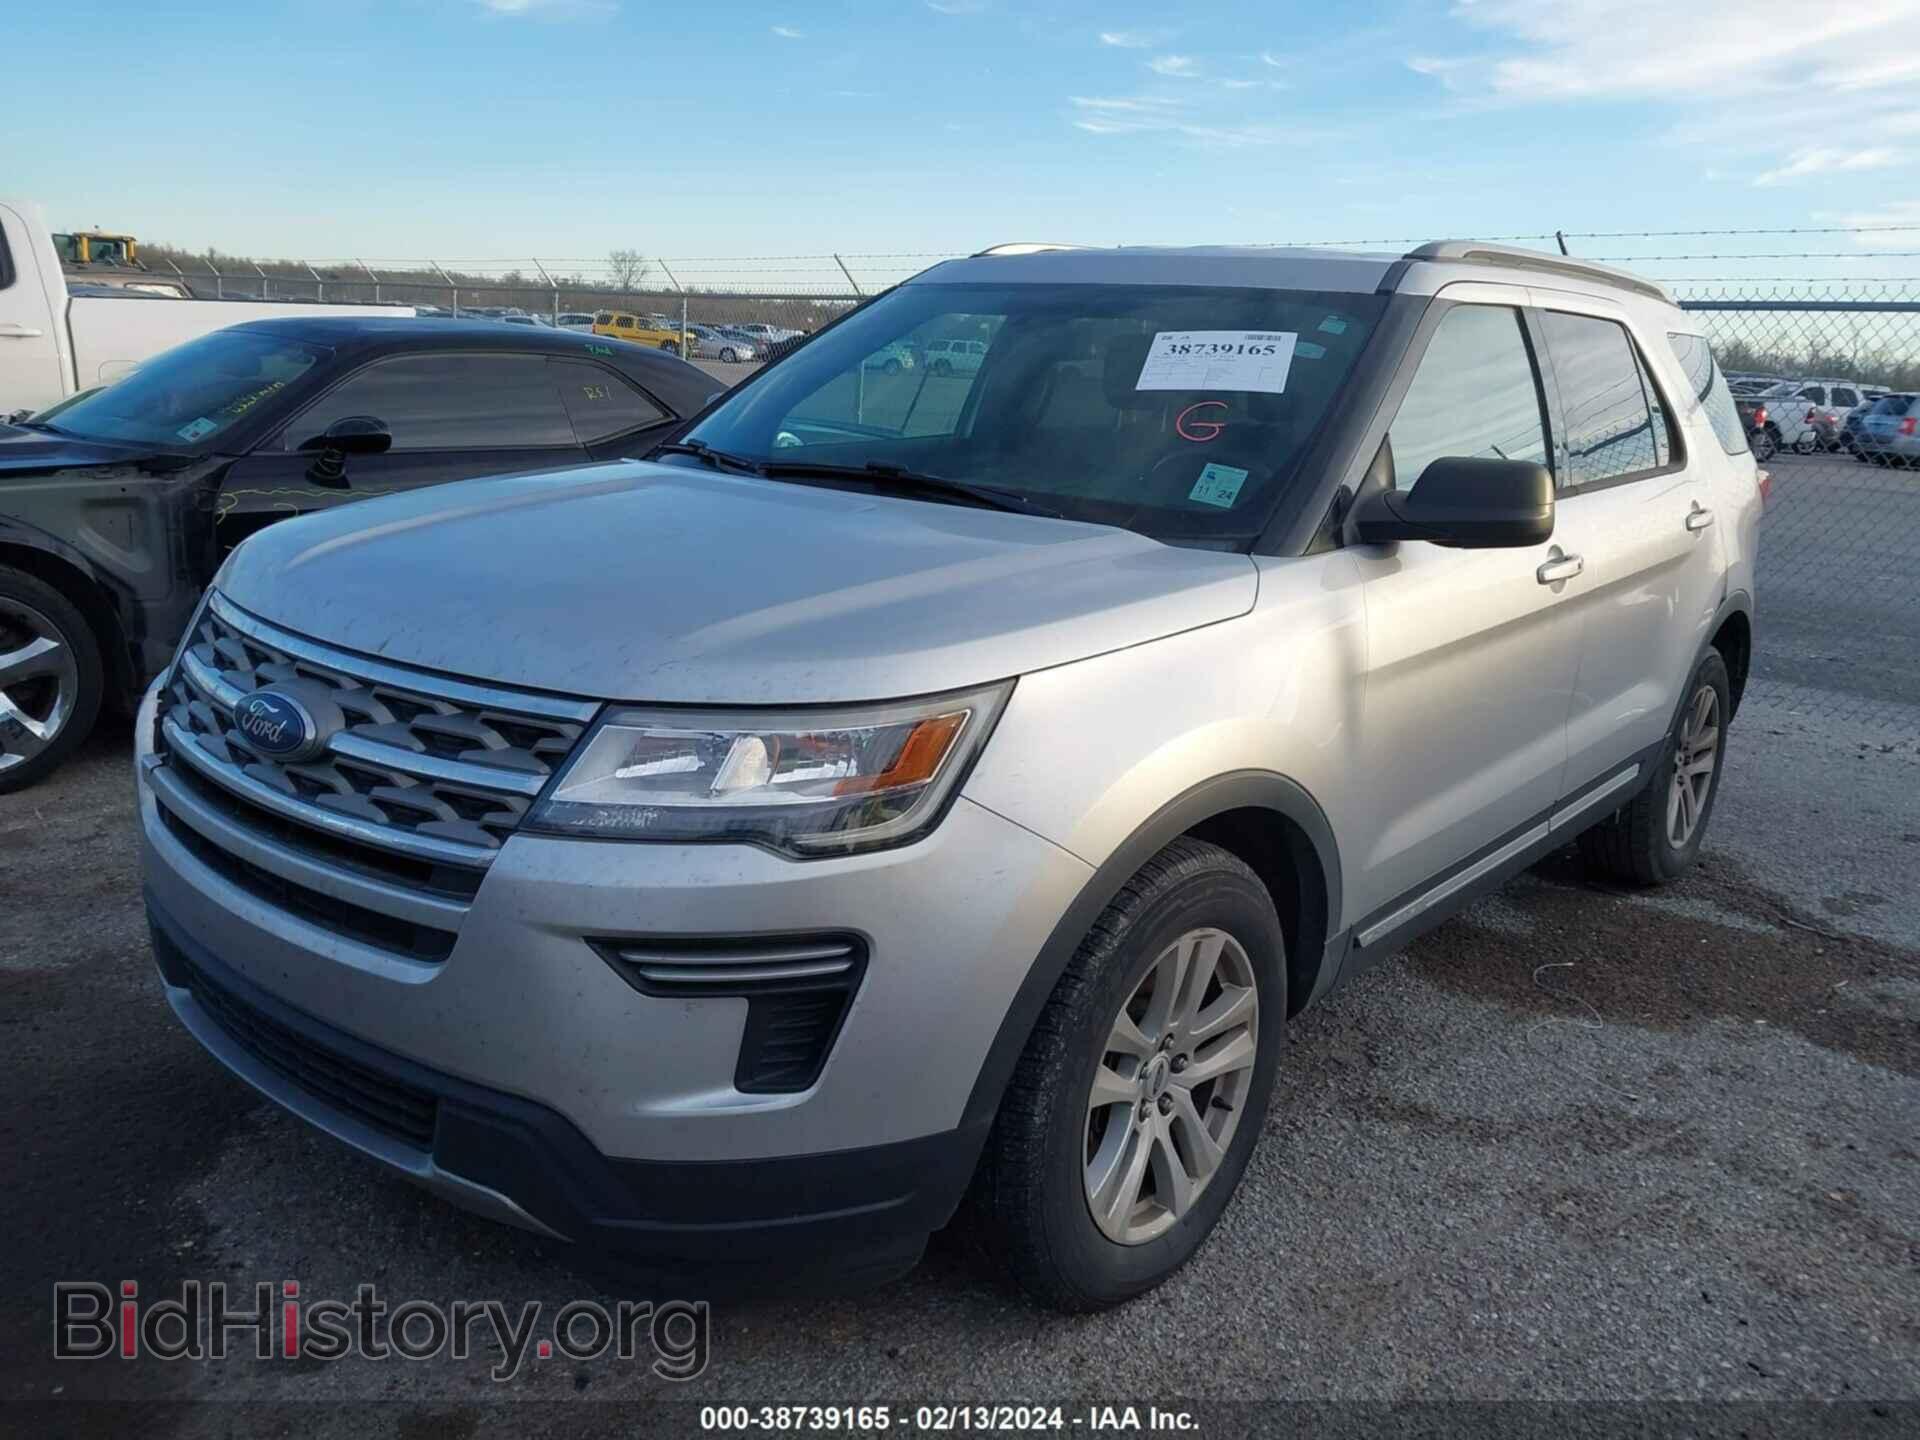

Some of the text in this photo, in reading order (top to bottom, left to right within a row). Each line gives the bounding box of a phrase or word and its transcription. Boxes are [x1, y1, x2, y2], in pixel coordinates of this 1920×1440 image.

[1164, 343, 1277, 356] 38739165
[1175, 401, 1229, 442] G
[242, 699, 288, 743] Ford
